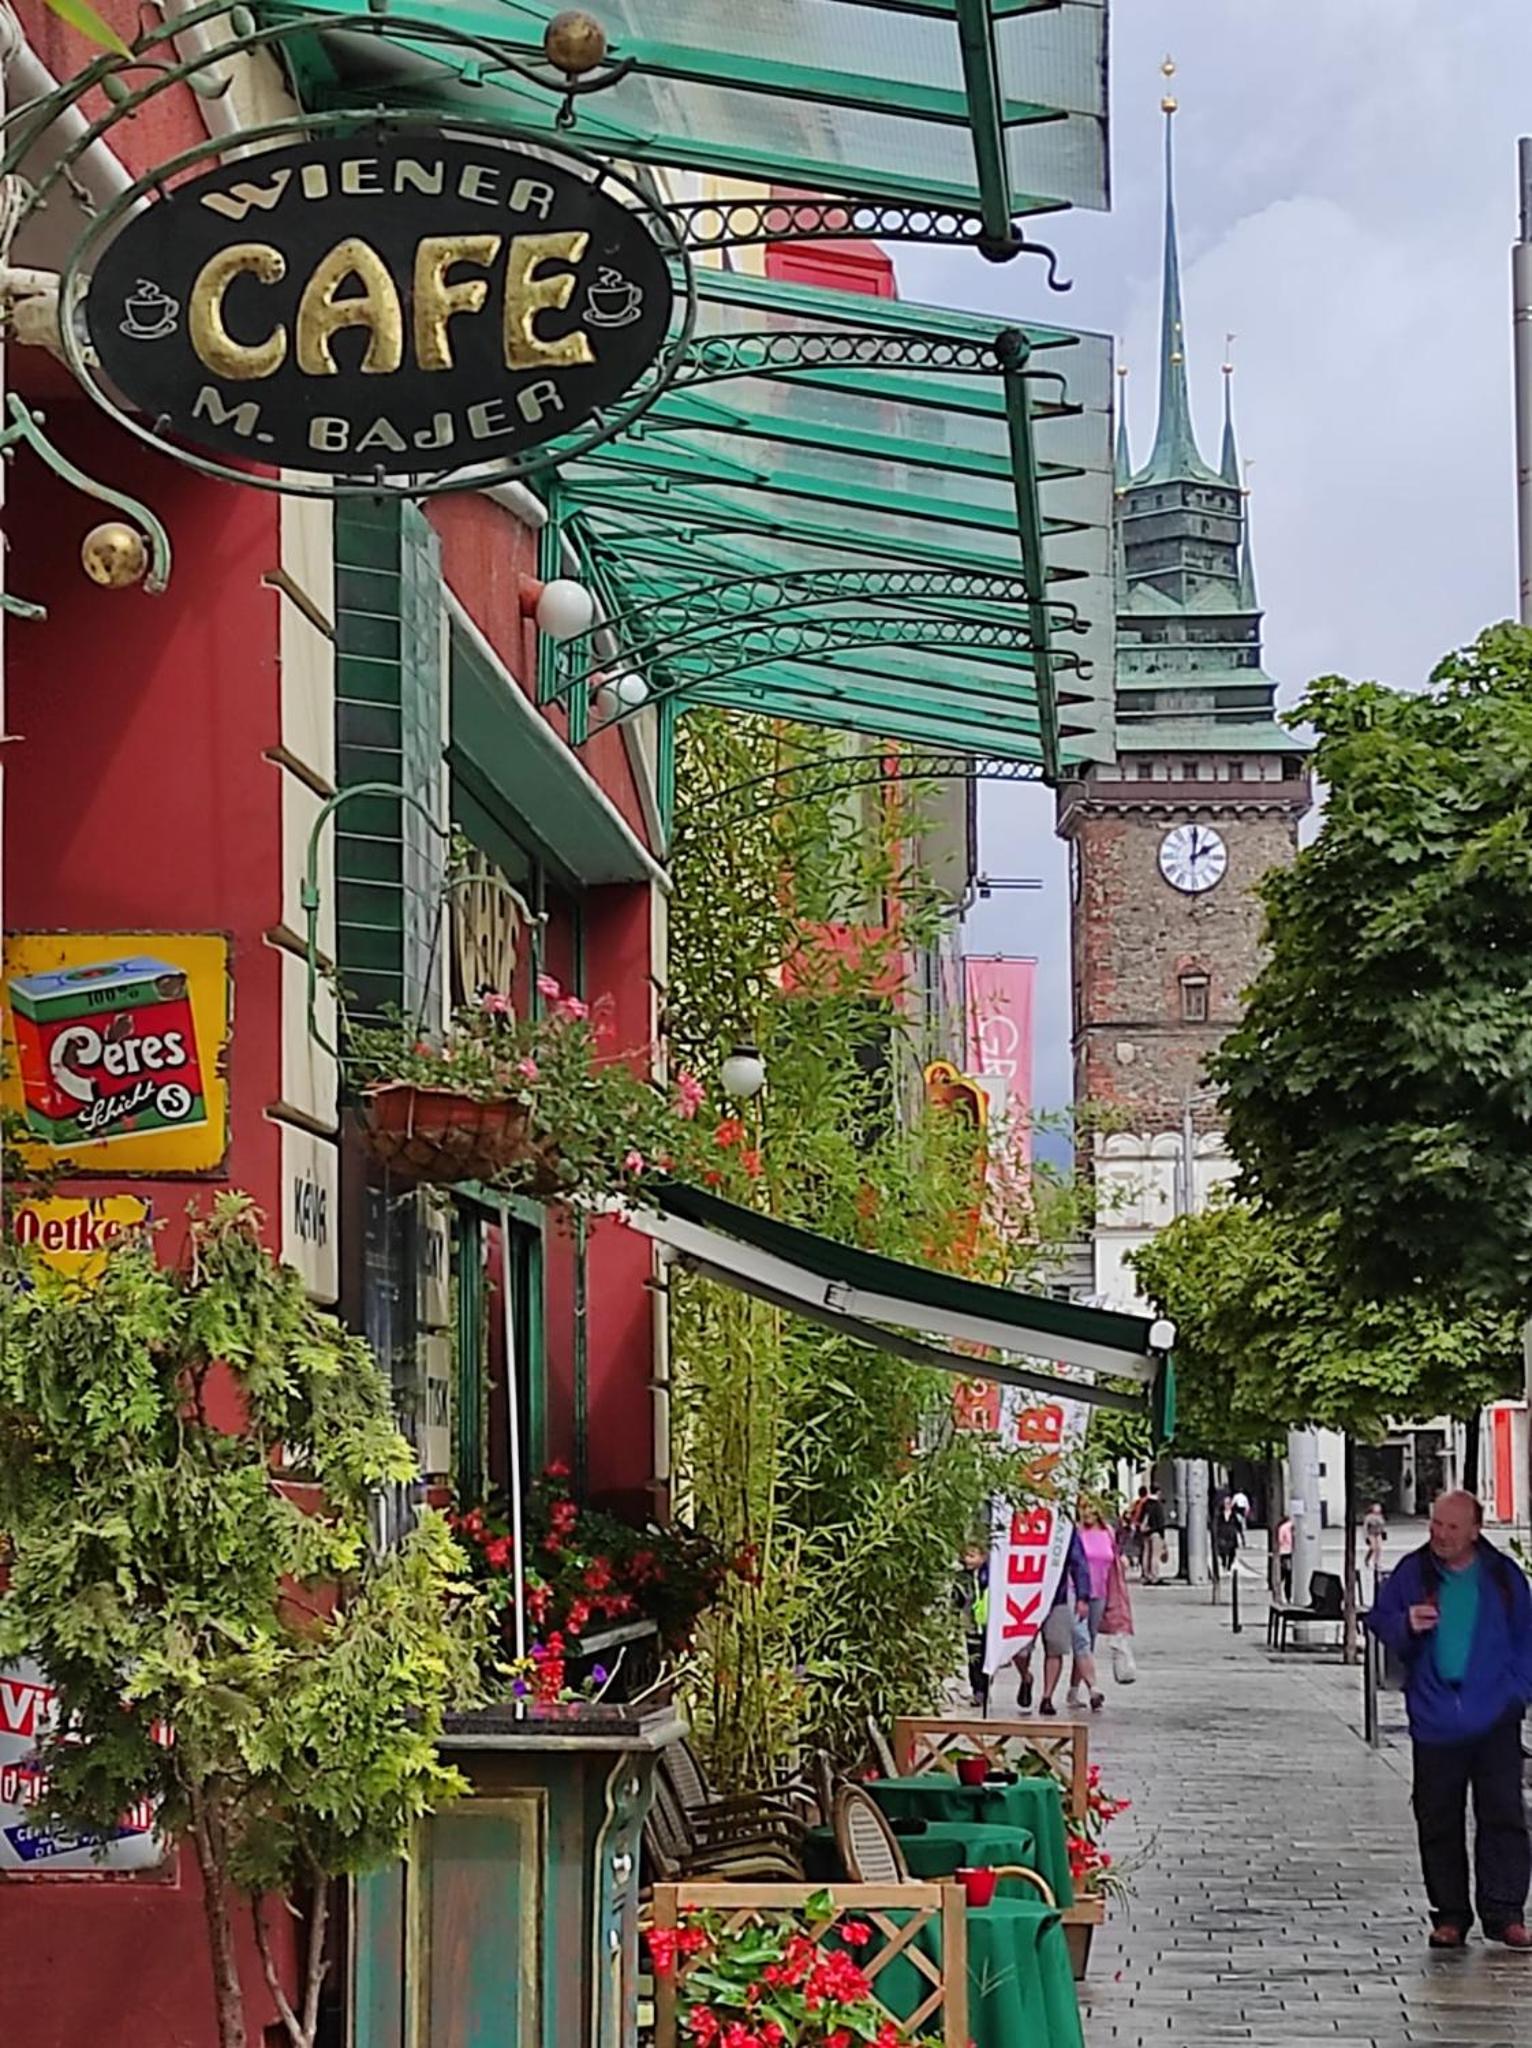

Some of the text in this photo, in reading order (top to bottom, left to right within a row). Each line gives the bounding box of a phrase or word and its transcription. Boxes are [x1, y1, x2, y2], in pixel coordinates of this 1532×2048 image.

[201, 158, 555, 221] WIENER
[188, 231, 596, 381] CAFE
[191, 379, 566, 453] M. BAJER
[51, 1025, 187, 1103] Ceres
